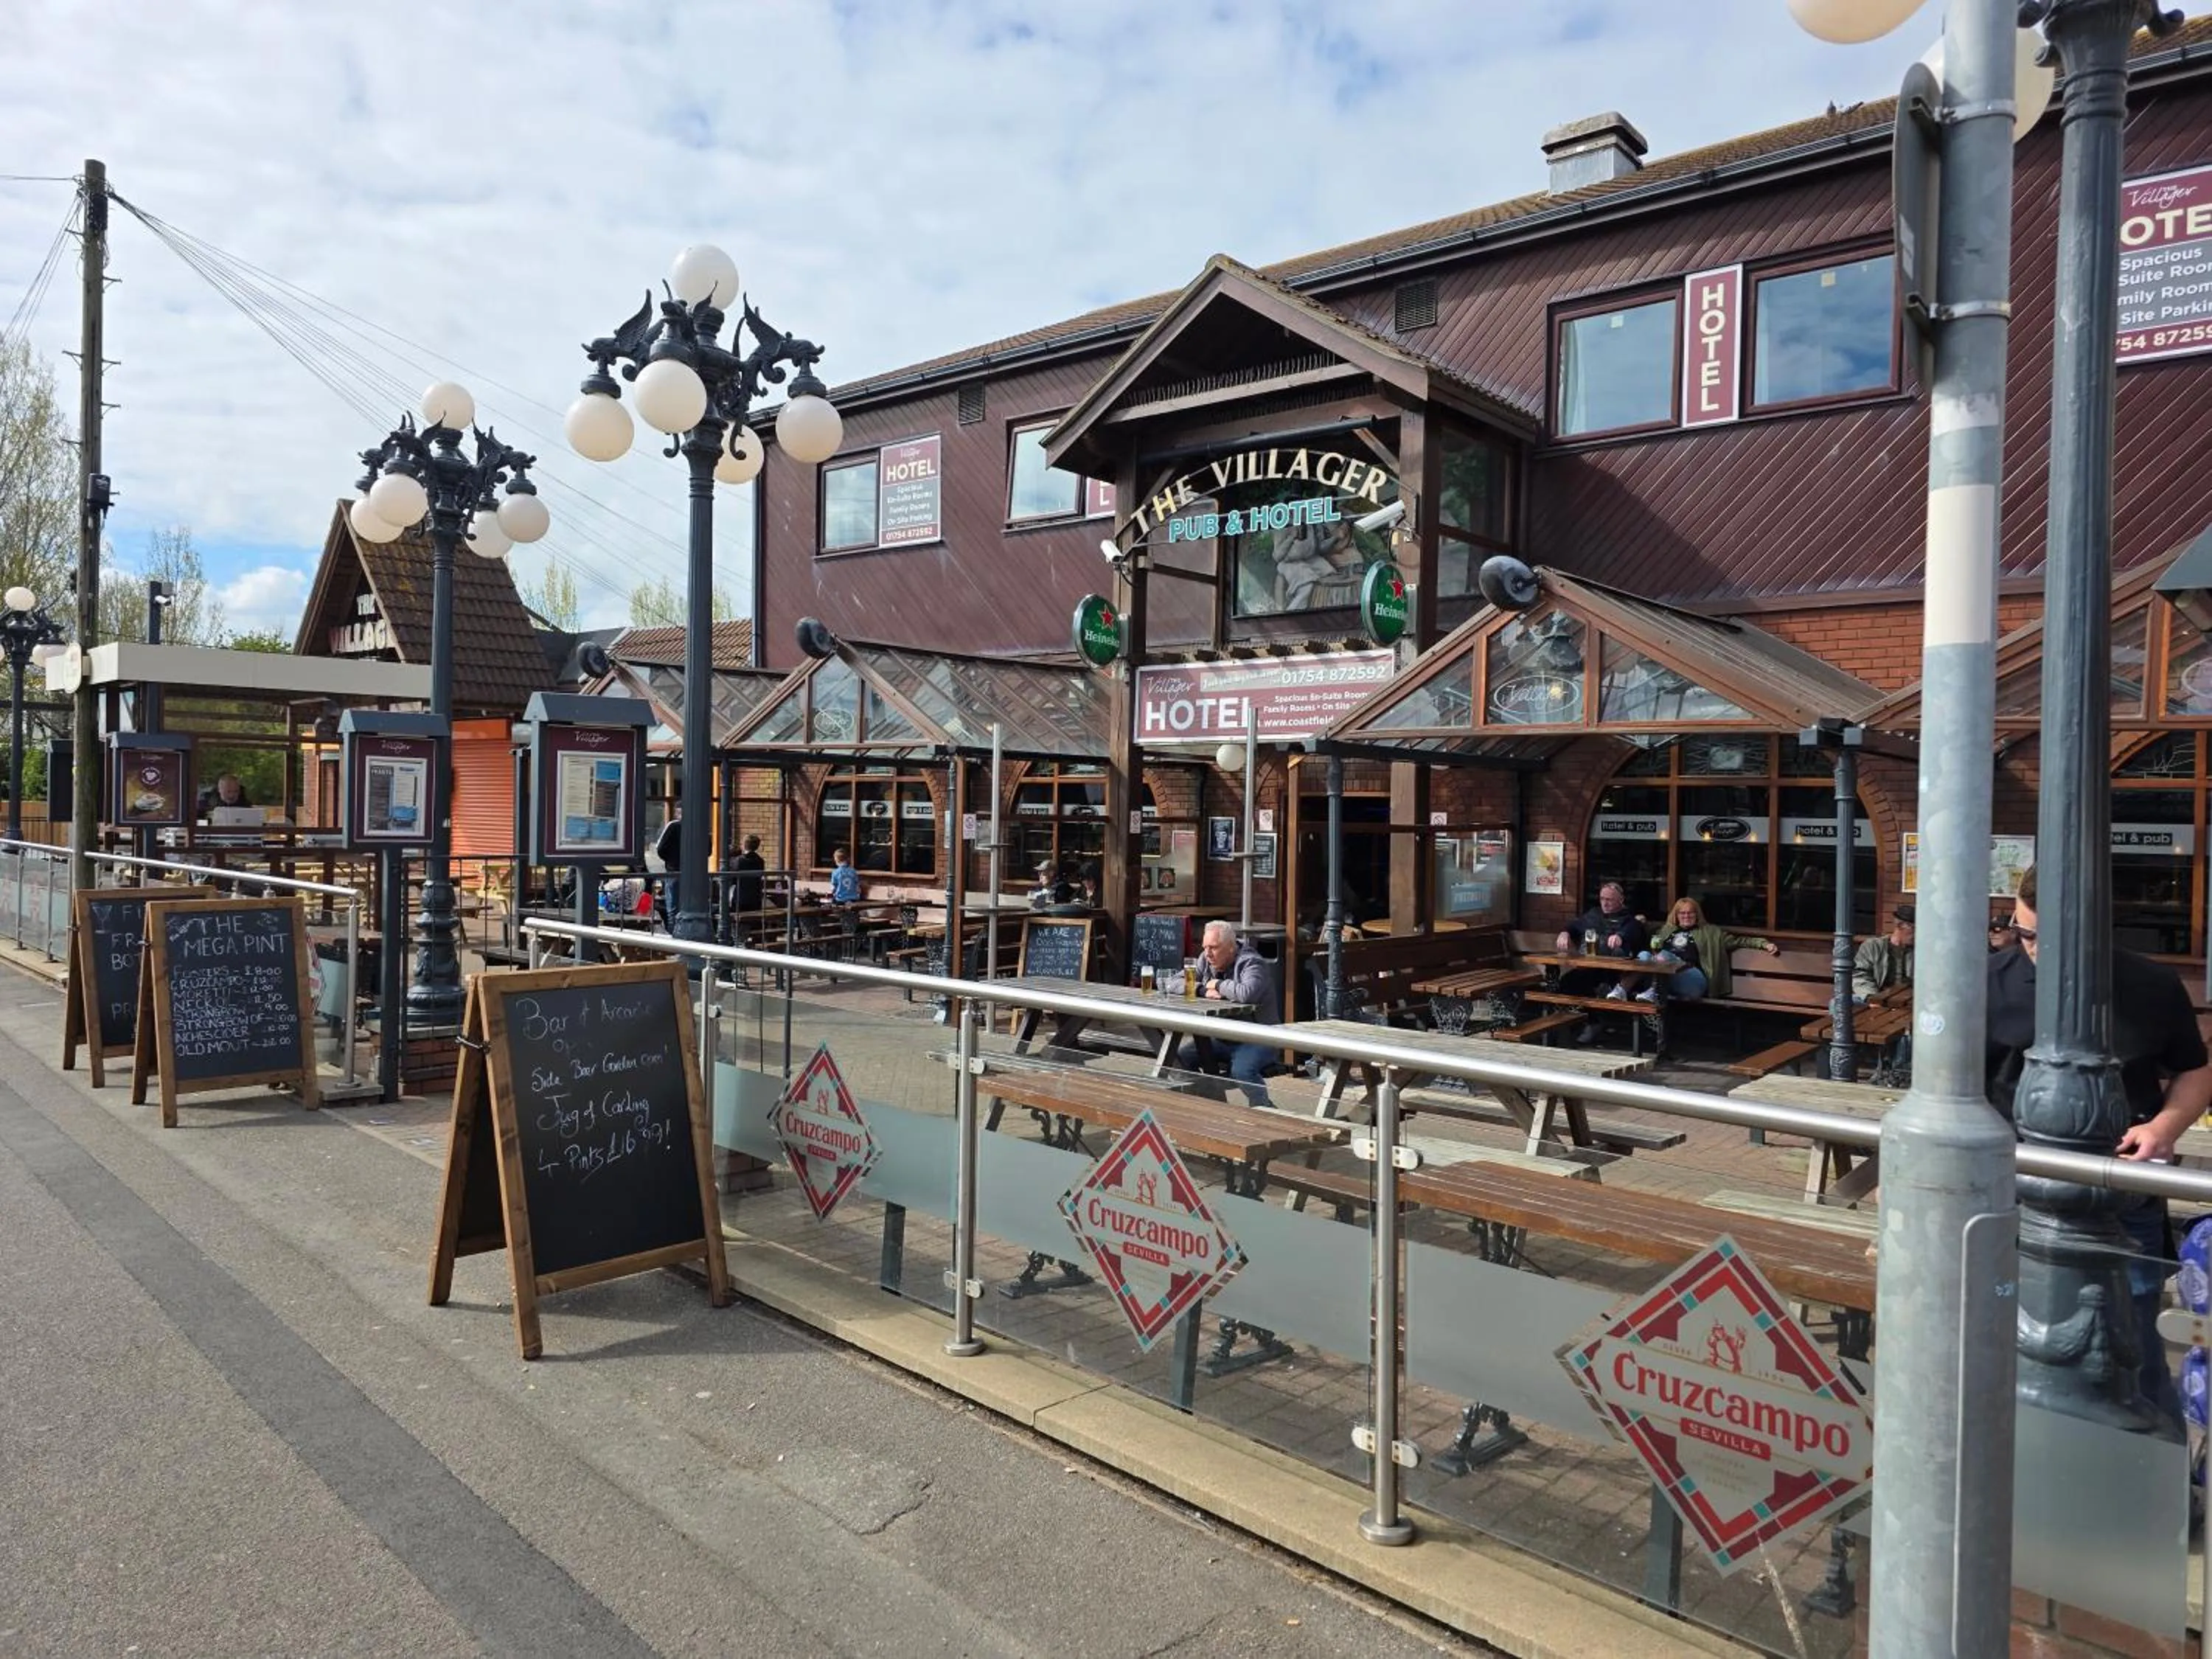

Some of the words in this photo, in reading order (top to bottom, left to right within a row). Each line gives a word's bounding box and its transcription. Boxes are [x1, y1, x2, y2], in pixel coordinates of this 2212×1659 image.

[2120, 203, 2212, 246] OTE
[2120, 246, 2203, 272] Spacious
[2118, 269, 2165, 287] Suite
[2169, 262, 2212, 278] Roo
[2118, 290, 2155, 307] mily
[2161, 281, 2212, 299] Room
[2121, 310, 2155, 325] Site
[2161, 301, 2212, 319] Parki
[1699, 282, 1726, 412] HOTEL
[2153, 325, 2212, 347] 87259
[886, 458, 936, 482] HOTEL
[1131, 475, 1200, 536] THE
[1211, 448, 1387, 504] VILLAGER
[1169, 514, 1220, 543] PUB
[1225, 509, 1243, 535] &
[1251, 496, 1341, 532] HOTEL
[1281, 669, 1325, 684] 01754
[1329, 665, 1386, 681] 872592
[1264, 705, 1287, 714] Family
[1290, 703, 1315, 712] Rooms
[1275, 694, 1309, 703] Spacious
[1344, 691, 1369, 700] Room
[1145, 698, 1259, 731] HOTEL
[2143, 832, 2171, 845] pub
[184, 936, 238, 957] MEGA
[244, 933, 289, 953] PINT
[515, 998, 569, 1040] Bar
[537, 1093, 580, 1139] Jug
[602, 1090, 650, 1131] Carling
[785, 1111, 861, 1155] Cruzcampo
[1088, 1197, 1210, 1259] Cruzcampo
[1126, 1244, 1165, 1262] SEVILLA
[1613, 1350, 1850, 1457] Cruzcampo
[1688, 1423, 1763, 1455] SEVILLA
